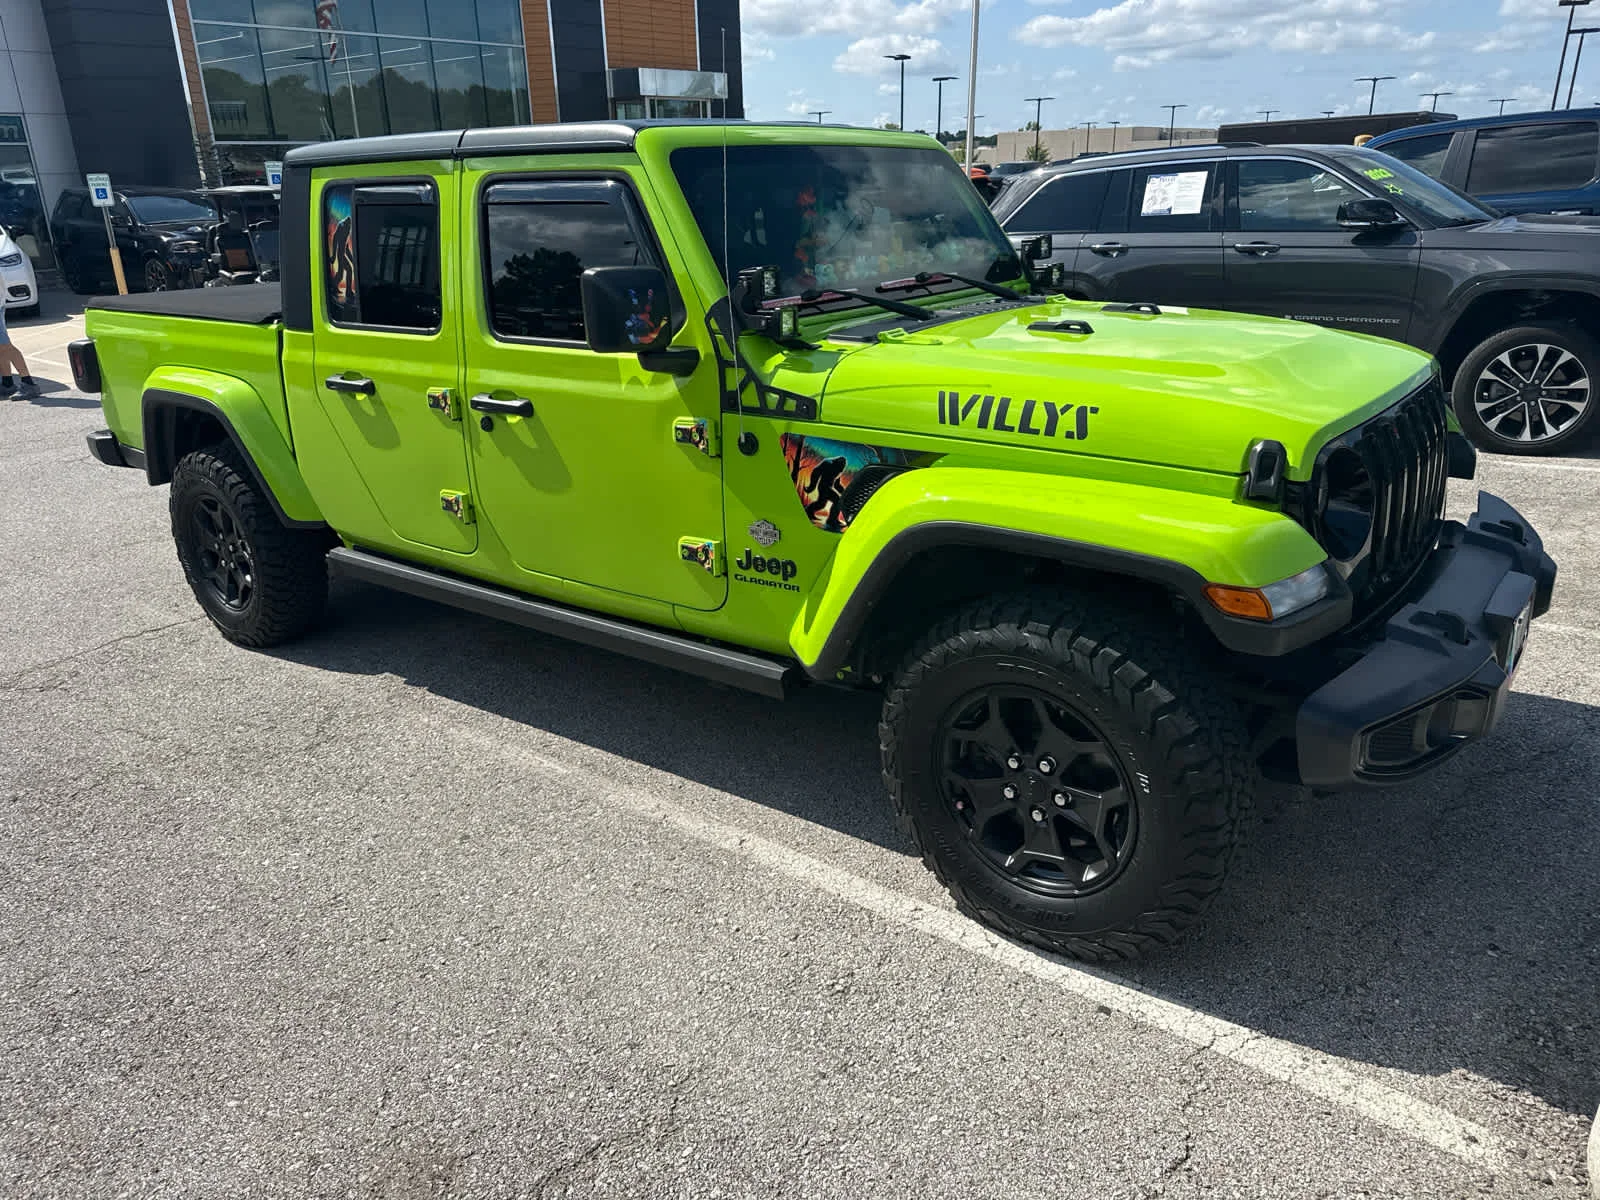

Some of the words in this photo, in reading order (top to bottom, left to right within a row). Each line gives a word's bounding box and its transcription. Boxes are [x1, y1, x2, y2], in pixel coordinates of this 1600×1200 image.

[1336, 316, 1401, 324] CHEROKEE
[938, 390, 1100, 441] WILLYS
[735, 547, 798, 582] Jeep
[733, 573, 801, 593] GLADIATOR
